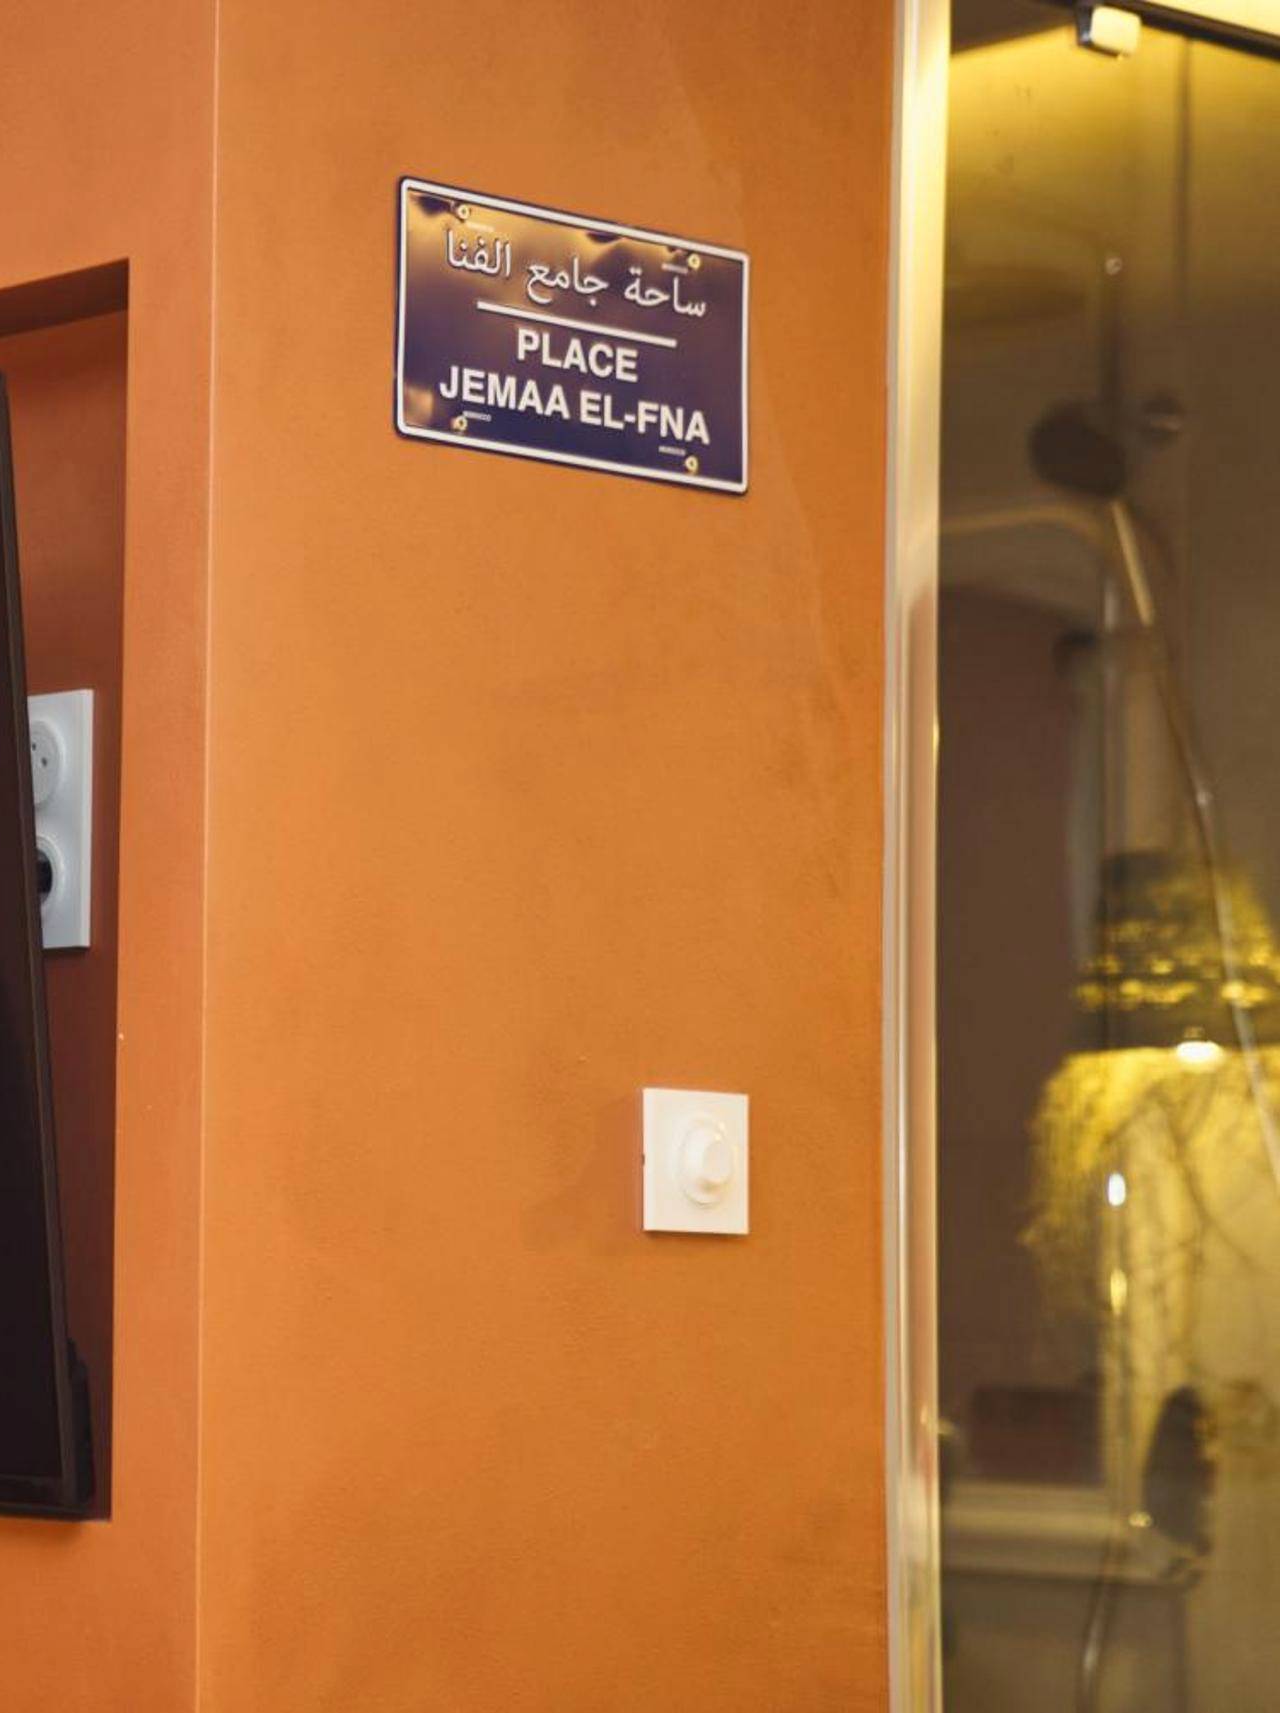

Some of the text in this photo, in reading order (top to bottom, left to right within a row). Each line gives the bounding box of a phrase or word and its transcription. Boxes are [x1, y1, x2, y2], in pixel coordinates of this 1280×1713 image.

[446, 229, 707, 317] ساحة جامع الفنا
[517, 328, 638, 383] PLACE
[439, 366, 710, 445] JEMAA EL-FNA
